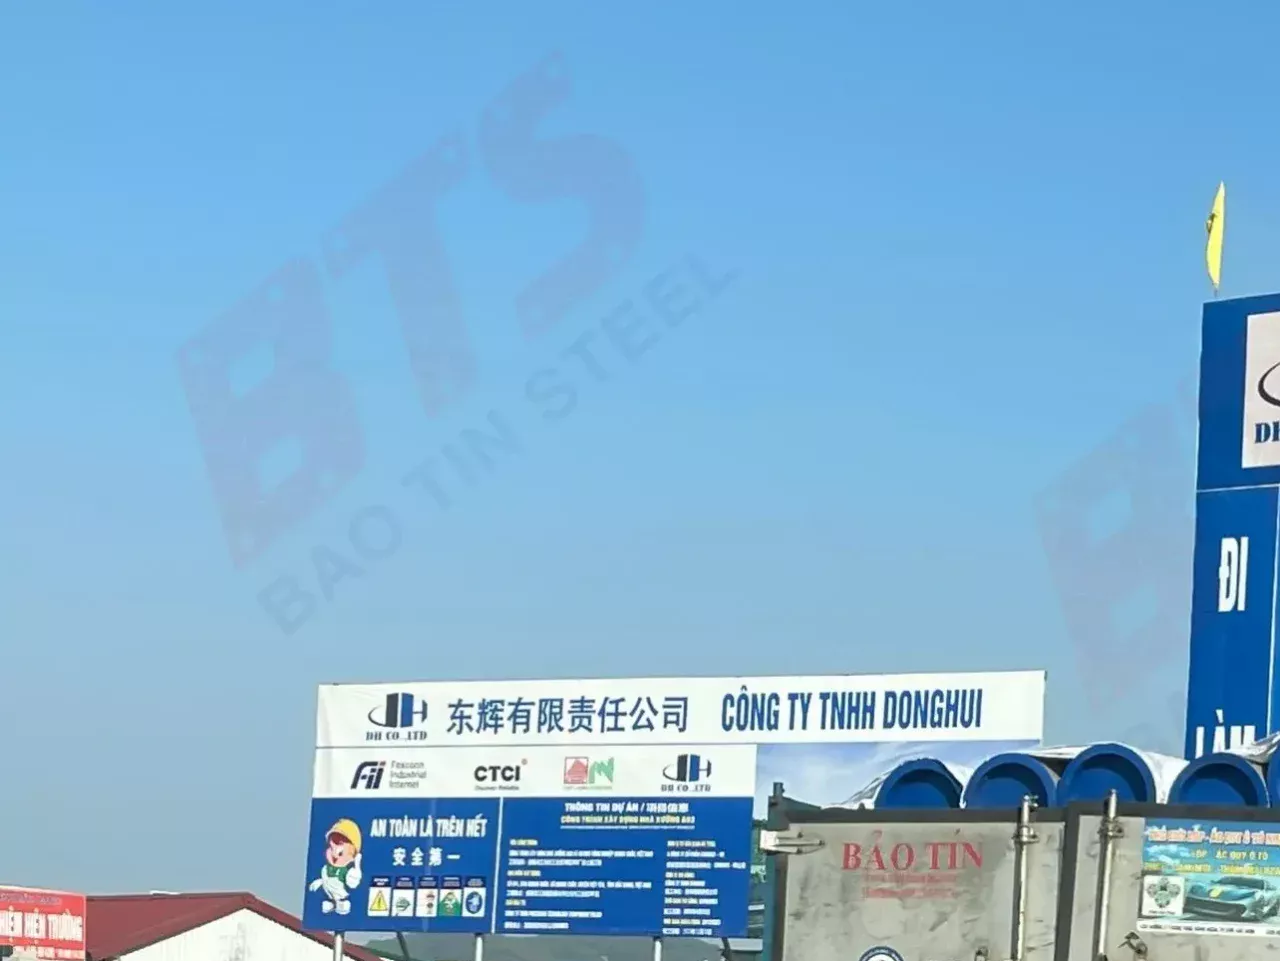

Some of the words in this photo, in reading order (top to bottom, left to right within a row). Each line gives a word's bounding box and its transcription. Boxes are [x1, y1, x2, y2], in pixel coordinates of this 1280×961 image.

[1218, 536, 1249, 612] ĐI
[446, 696, 689, 735] 东辉有限责任公司
[721, 685, 780, 732] CÔNG
[787, 692, 812, 731] TY
[819, 691, 876, 730] TNHH
[882, 688, 983, 729] DONGHUI
[366, 731, 382, 741] DH
[474, 765, 521, 782] CTCI
[370, 818, 387, 838] AN
[389, 814, 418, 838] TOÀN
[419, 815, 434, 838] LÀ
[436, 815, 465, 838] TRÊN
[466, 813, 488, 838] HẾT
[392, 847, 461, 866] 安全第一
[841, 829, 916, 871] BẢO
